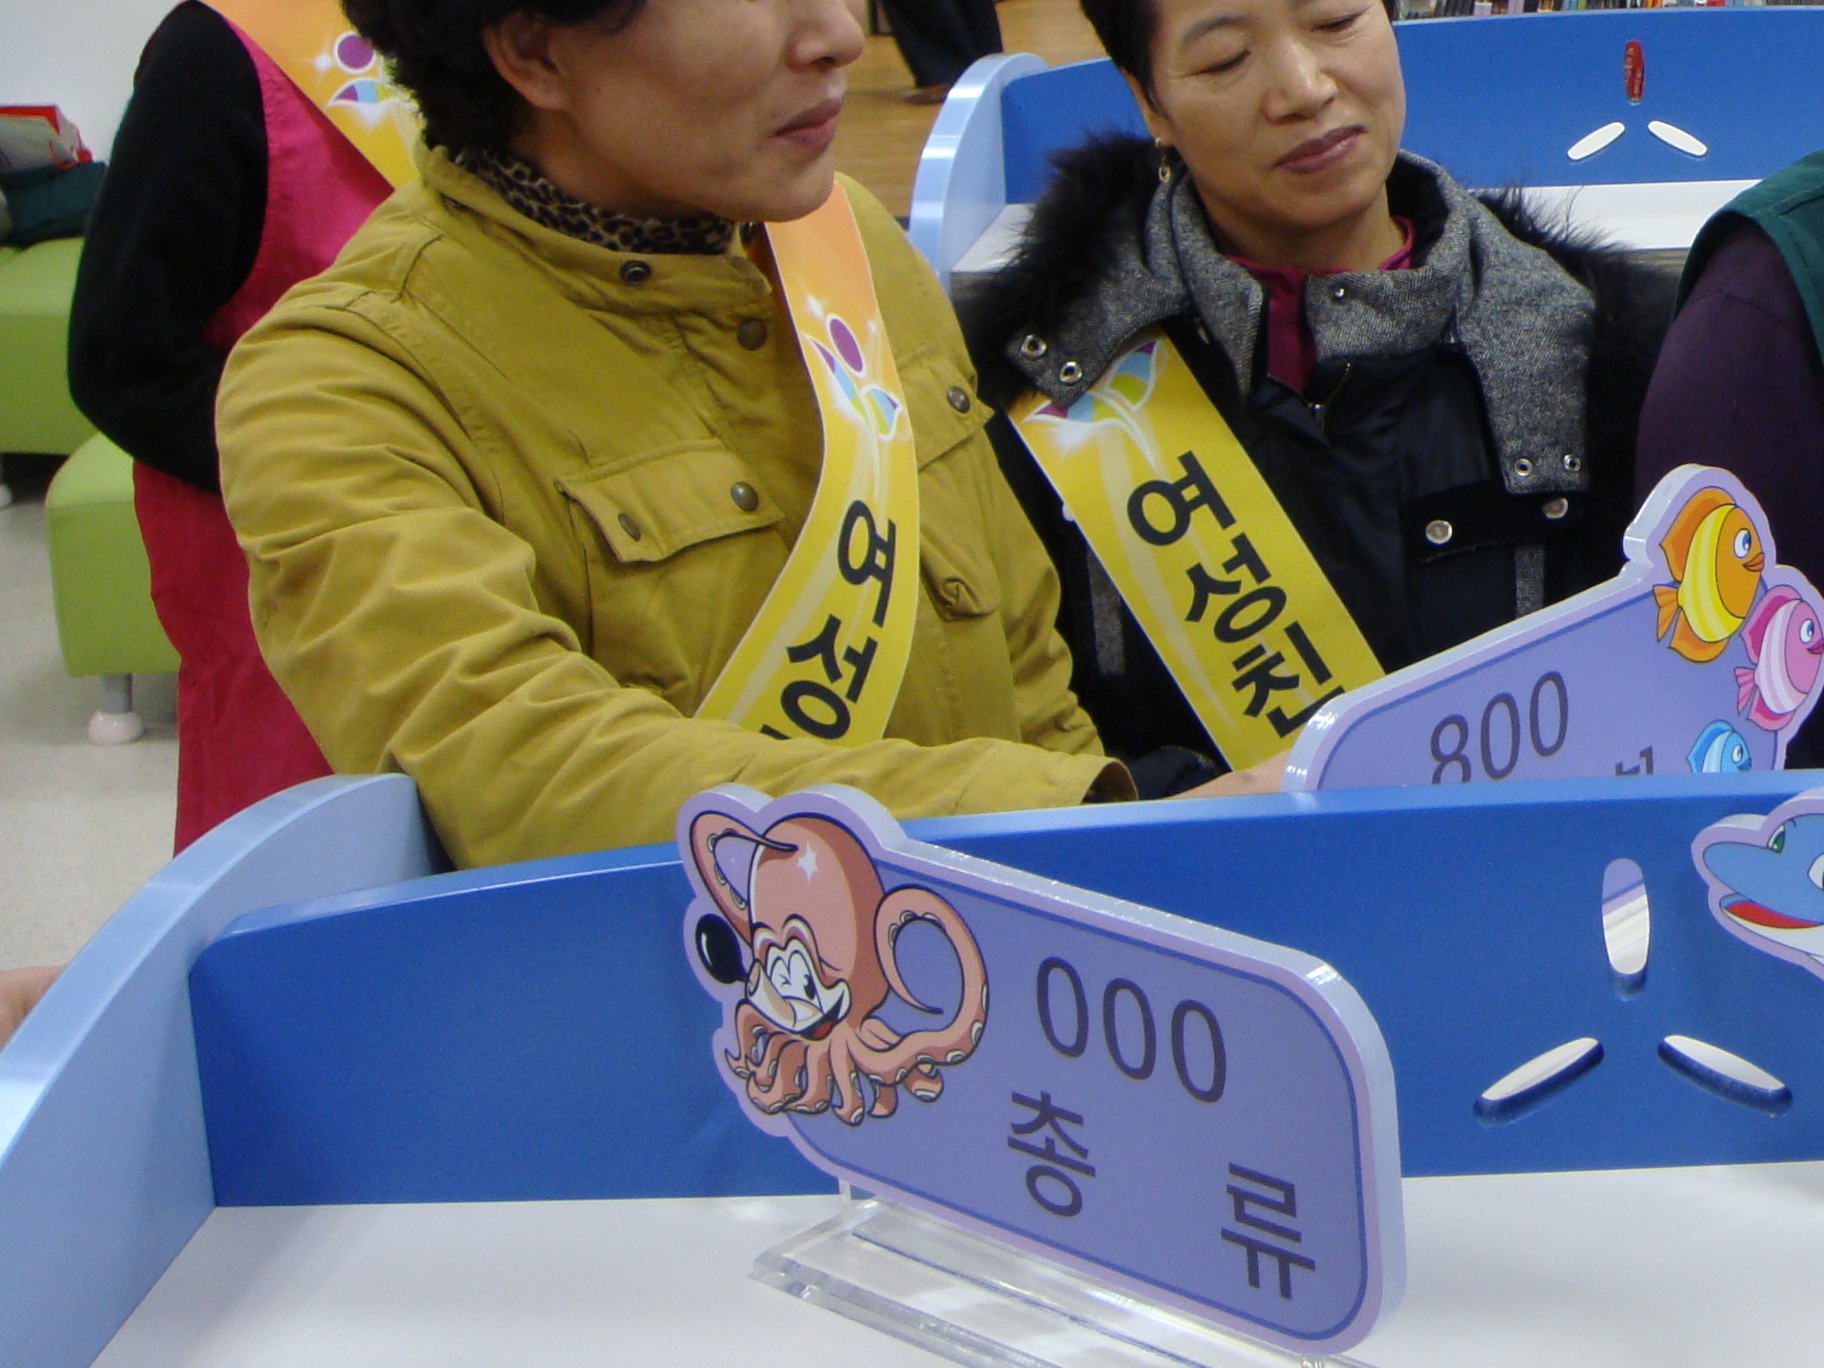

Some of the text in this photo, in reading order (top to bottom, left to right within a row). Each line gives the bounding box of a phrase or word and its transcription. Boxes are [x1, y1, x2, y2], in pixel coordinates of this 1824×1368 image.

[759, 499, 897, 740] 여성
[1430, 670, 1569, 785] 800
[1036, 956, 1227, 1104] 000
